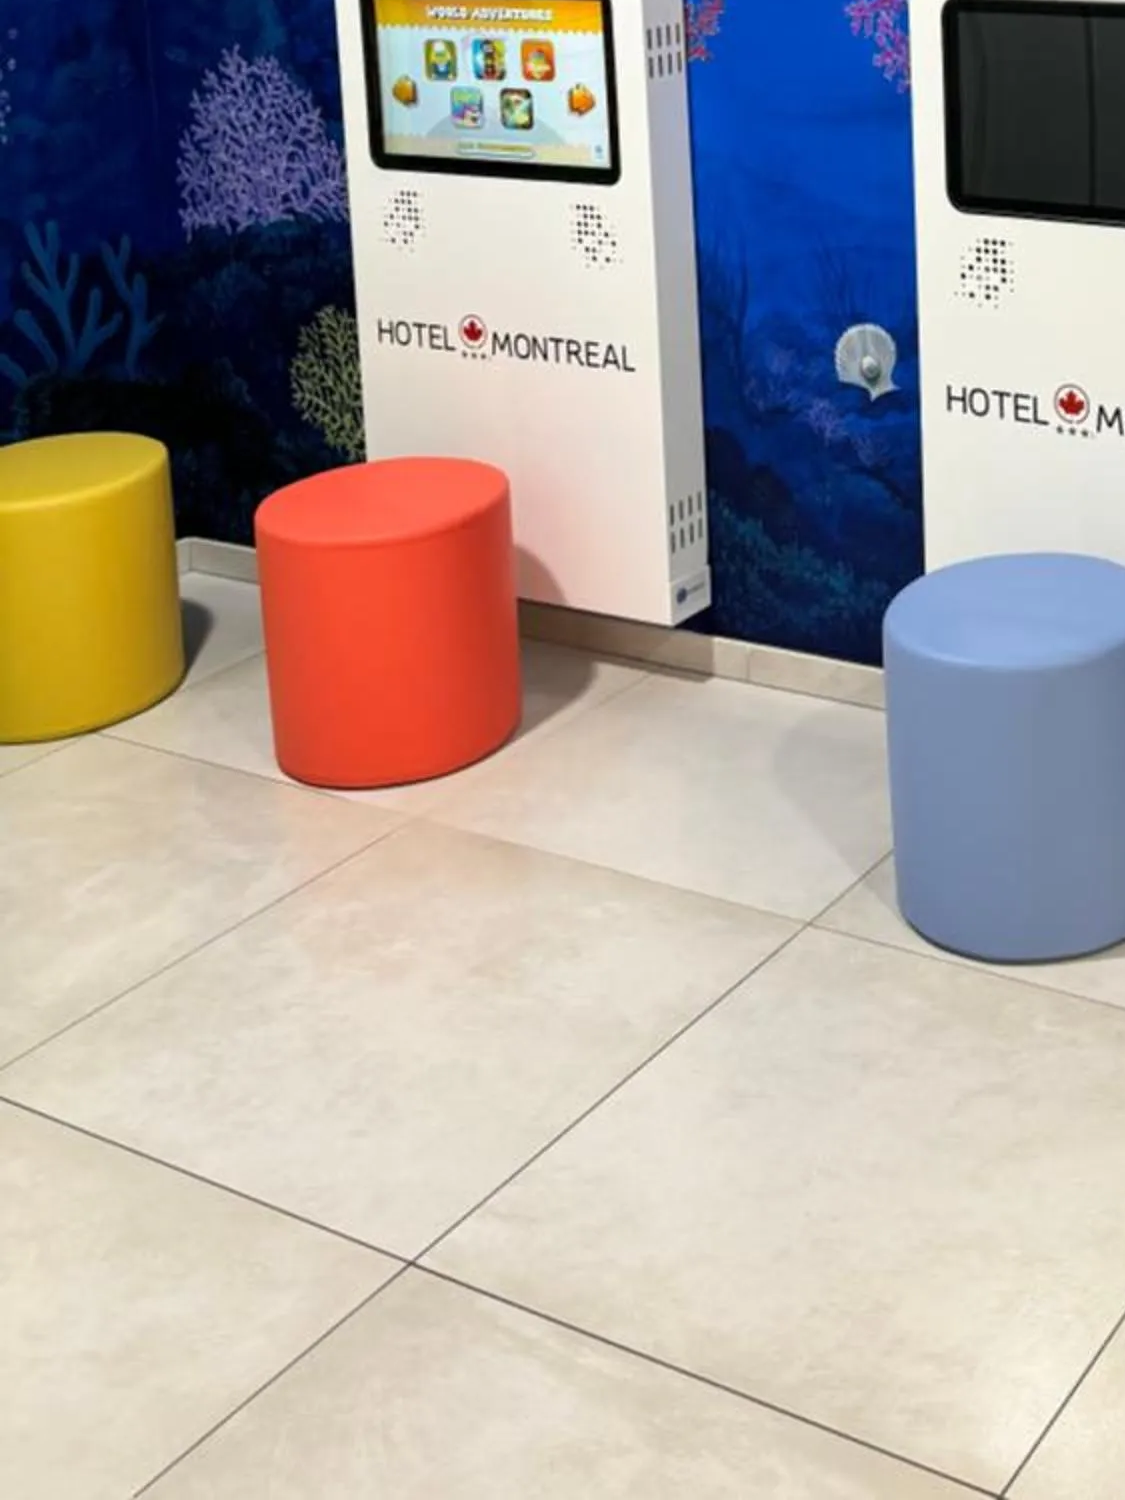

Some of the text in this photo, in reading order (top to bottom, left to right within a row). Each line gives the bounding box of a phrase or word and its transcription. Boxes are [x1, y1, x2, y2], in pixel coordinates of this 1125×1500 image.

[377, 318, 636, 372] HOTEL MONTREAL
[946, 385, 1050, 426] HOTEL
